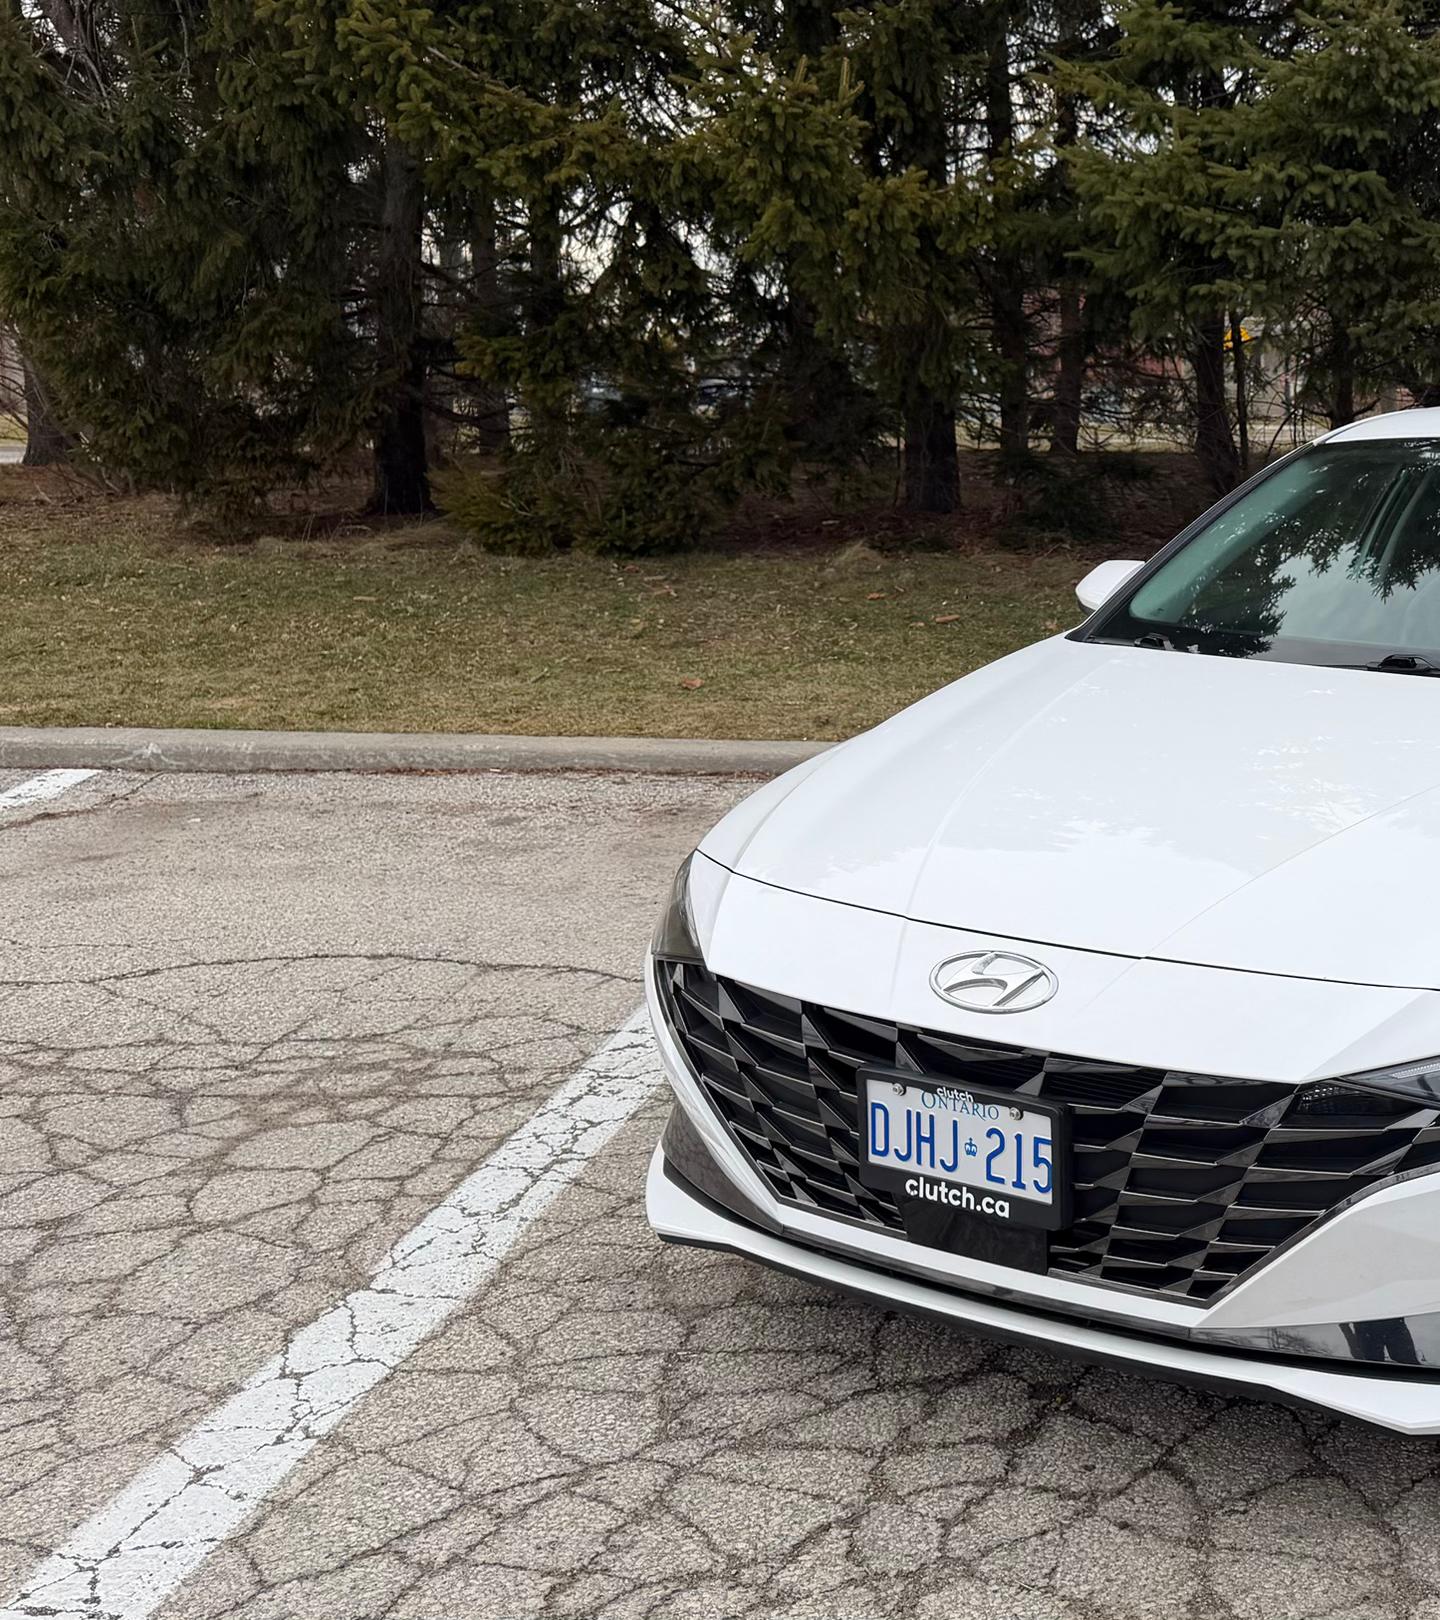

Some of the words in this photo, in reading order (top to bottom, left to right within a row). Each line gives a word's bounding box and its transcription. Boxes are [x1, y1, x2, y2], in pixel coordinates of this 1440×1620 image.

[921, 1091, 999, 1121] ONTARIO
[936, 1086, 974, 1102] clutch
[870, 1102, 959, 1173] DJHJ
[985, 1127, 1053, 1194] 215
[905, 1177, 1010, 1219] clutch.ca
